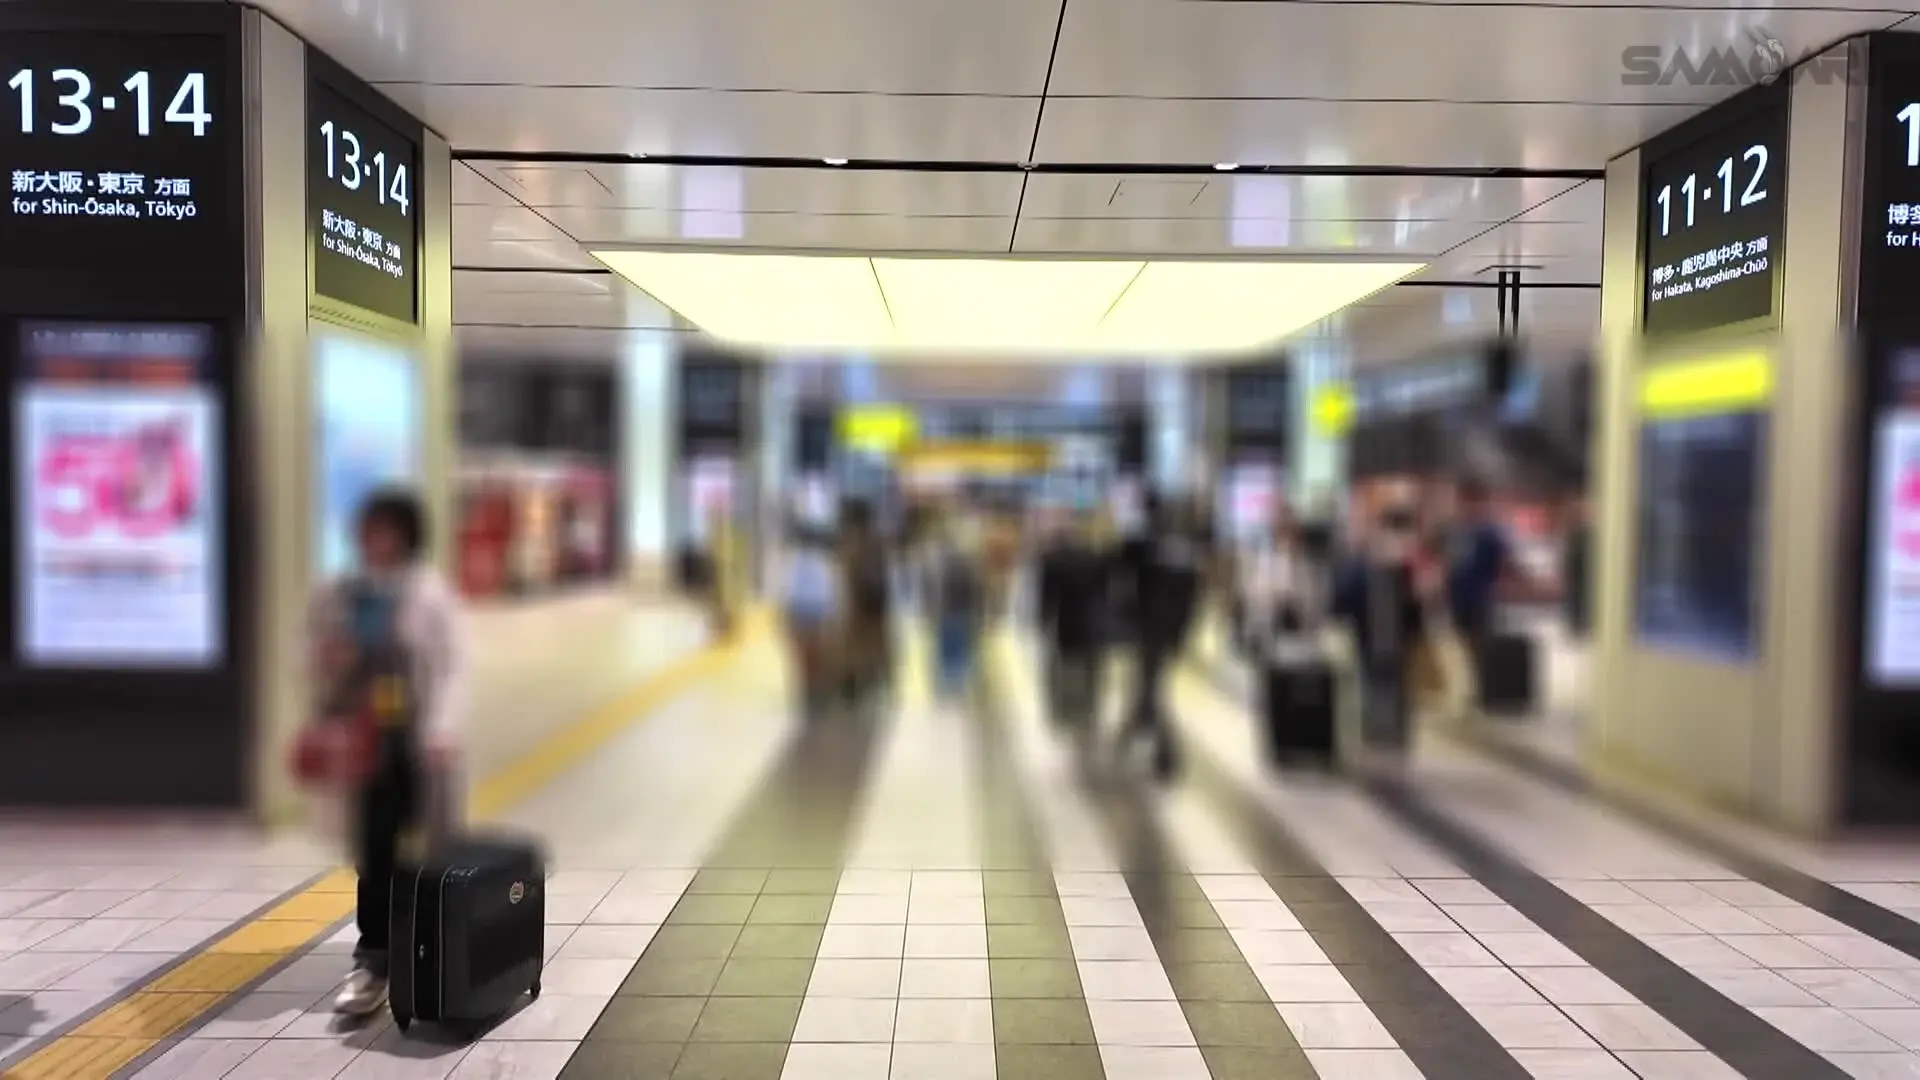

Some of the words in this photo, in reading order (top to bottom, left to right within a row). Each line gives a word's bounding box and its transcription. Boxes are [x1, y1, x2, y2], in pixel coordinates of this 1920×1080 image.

[12, 170, 145, 195] 新大阪・東京
[154, 177, 190, 196] 方面
[12, 197, 38, 214] for
[42, 197, 140, 218] Shin-Ōsaka,
[145, 200, 197, 220] Tōkyō
[323, 232, 336, 250] for
[1886, 231, 1909, 247] for
[386, 242, 401, 260] 方面
[1652, 288, 1663, 302] for
[1664, 282, 1694, 298] Hakata,
